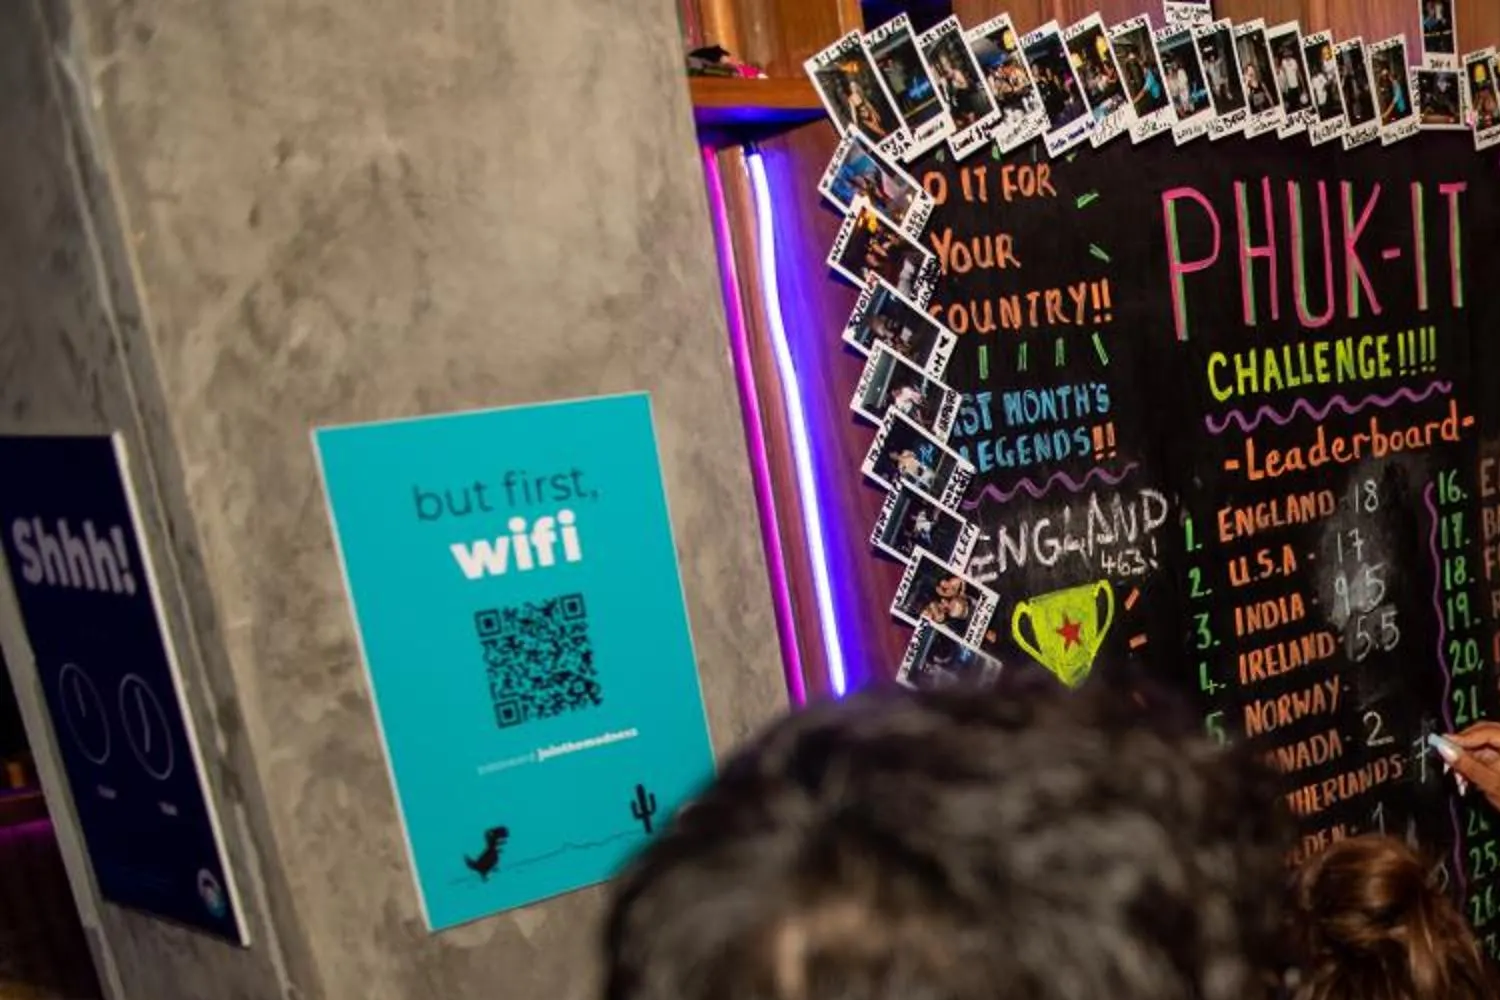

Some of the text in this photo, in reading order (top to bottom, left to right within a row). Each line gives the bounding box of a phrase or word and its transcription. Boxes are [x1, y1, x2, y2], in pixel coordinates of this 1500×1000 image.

[961, 166, 988, 203] IT
[1001, 162, 1057, 202] FOR
[929, 227, 1022, 276] YOUR
[1161, 175, 1468, 342] PHUK-IT
[1207, 325, 1437, 402] CHALLENGE!!!!
[1002, 382, 1111, 427] MONTH'S
[412, 466, 600, 522] but first,
[1184, 478, 1380, 551] 1. ENGLAND 18
[1438, 468, 1469, 505] 16.
[12, 516, 137, 596] Shhh!
[450, 509, 583, 580] wifi
[1441, 512, 1471, 550] 17.
[1188, 566, 1213, 599] 2.
[1228, 543, 1298, 588] U.S.A
[1444, 555, 1476, 591] 18.
[1193, 613, 1221, 649] 3.
[1234, 592, 1306, 637] INDIA
[1447, 591, 1482, 632] 19.
[1199, 661, 1227, 695] 4.
[1238, 631, 1336, 686] IRELAND
[1244, 674, 1342, 738] NORWAY
[1361, 711, 1395, 747] 2
[1453, 684, 1488, 725] 21.
